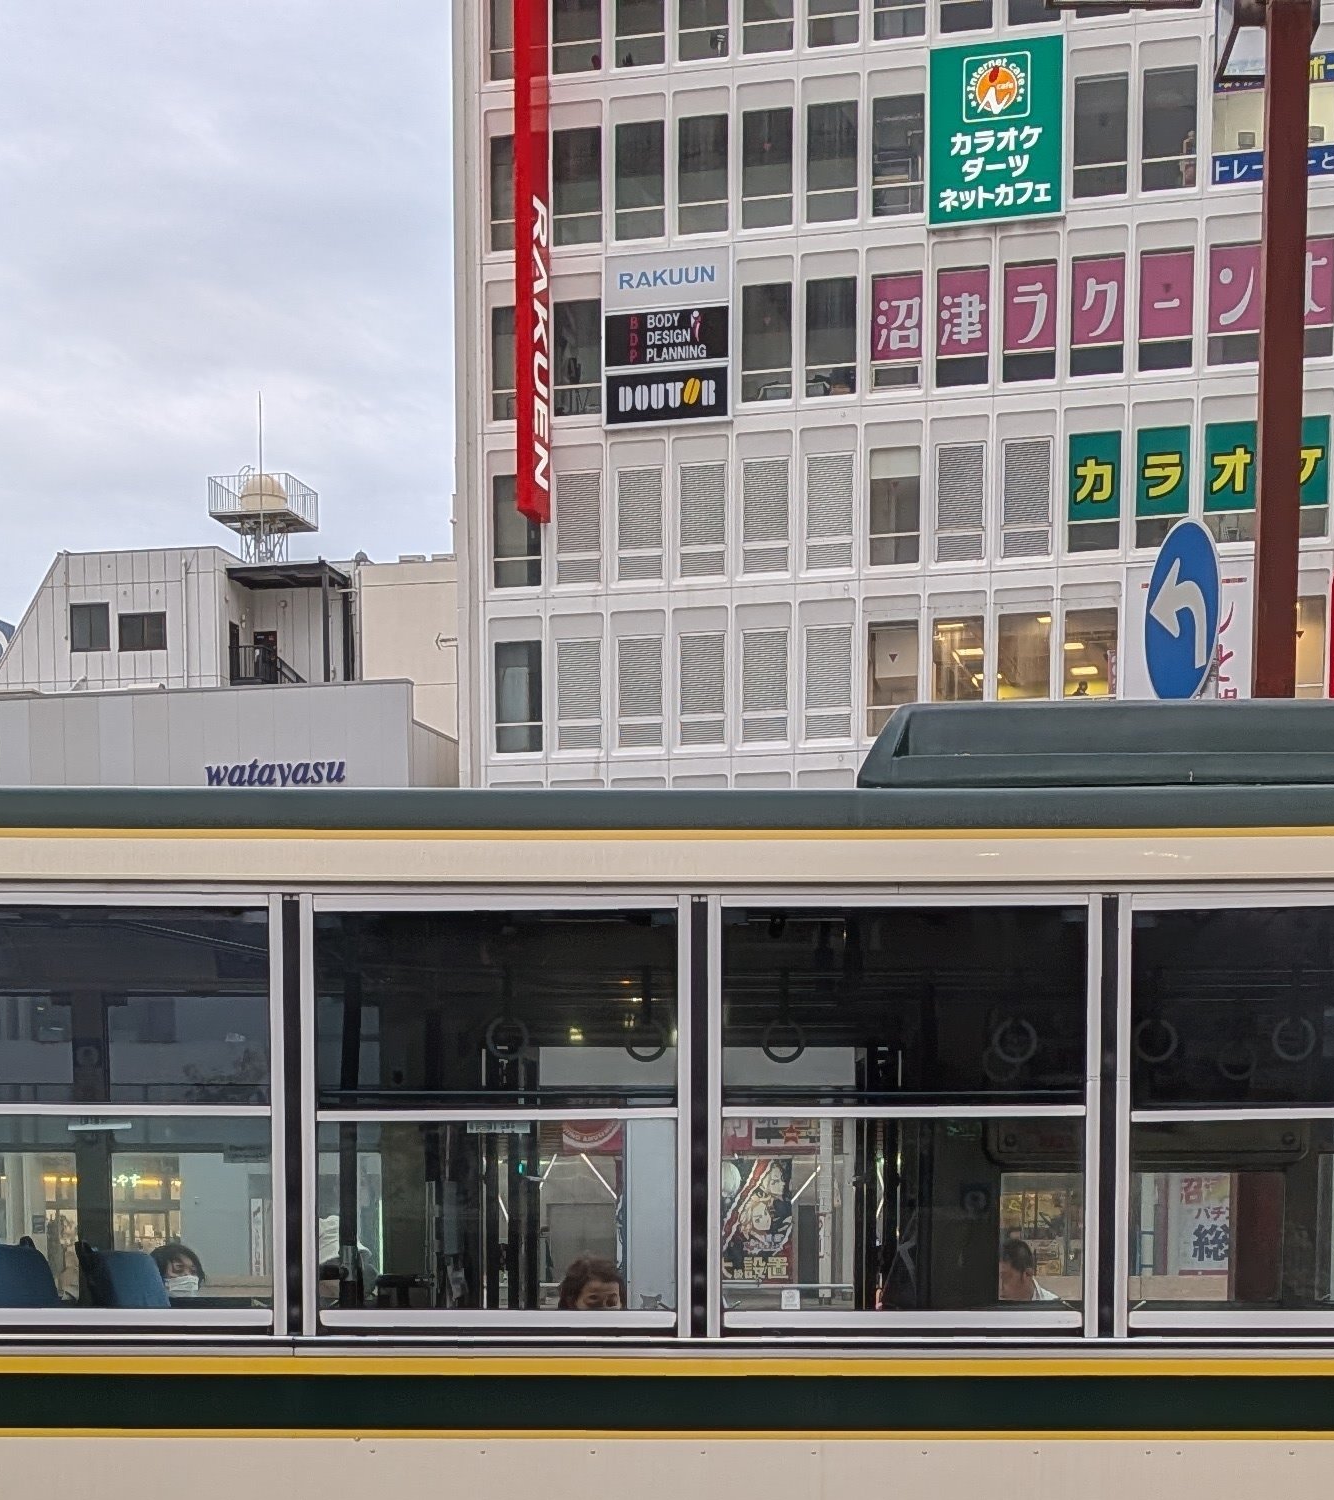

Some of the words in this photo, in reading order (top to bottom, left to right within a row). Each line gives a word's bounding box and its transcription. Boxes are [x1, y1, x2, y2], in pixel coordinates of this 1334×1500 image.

[950, 125, 1043, 156] カラオケ
[961, 153, 1030, 182] ダーツ
[938, 181, 1052, 212] ネットカフェ
[618, 265, 716, 290] RAKUUN
[646, 313, 680, 329] BODY
[532, 194, 550, 492] RAKUEN
[646, 328, 691, 345] DESIGN
[646, 344, 707, 362] PLANNING
[618, 377, 716, 412] DOUTOR
[204, 758, 347, 788] watayasu
